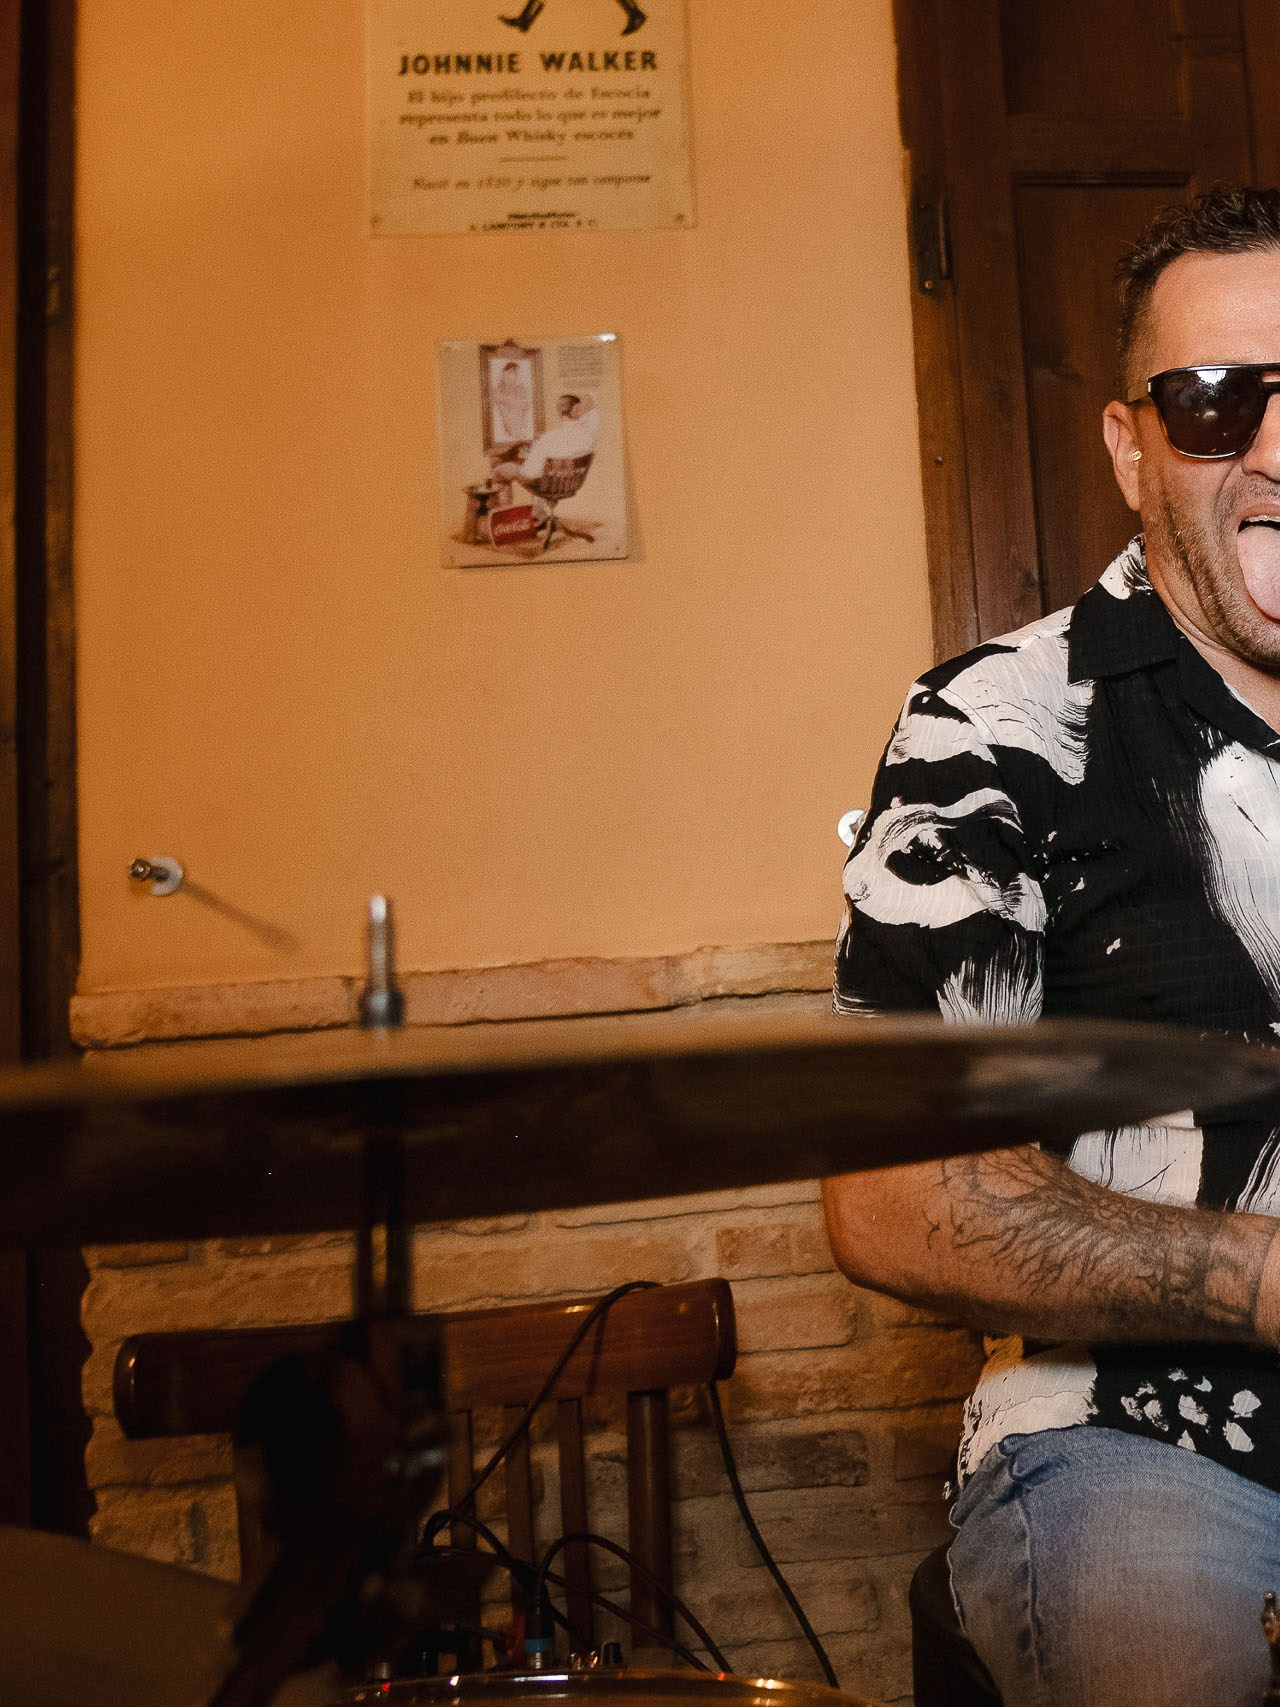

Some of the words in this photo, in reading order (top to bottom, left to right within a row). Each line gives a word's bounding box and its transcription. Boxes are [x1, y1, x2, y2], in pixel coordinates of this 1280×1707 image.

[398, 53, 522, 77] JOHNNIE
[538, 51, 659, 73] WALKER
[564, 87, 583, 99] de
[494, 110, 532, 123] todo
[536, 108, 552, 121] lo
[557, 110, 586, 125] que
[612, 106, 661, 125] mejor
[429, 134, 449, 145] en
[457, 131, 498, 145] Buen
[506, 128, 567, 146] Whisky
